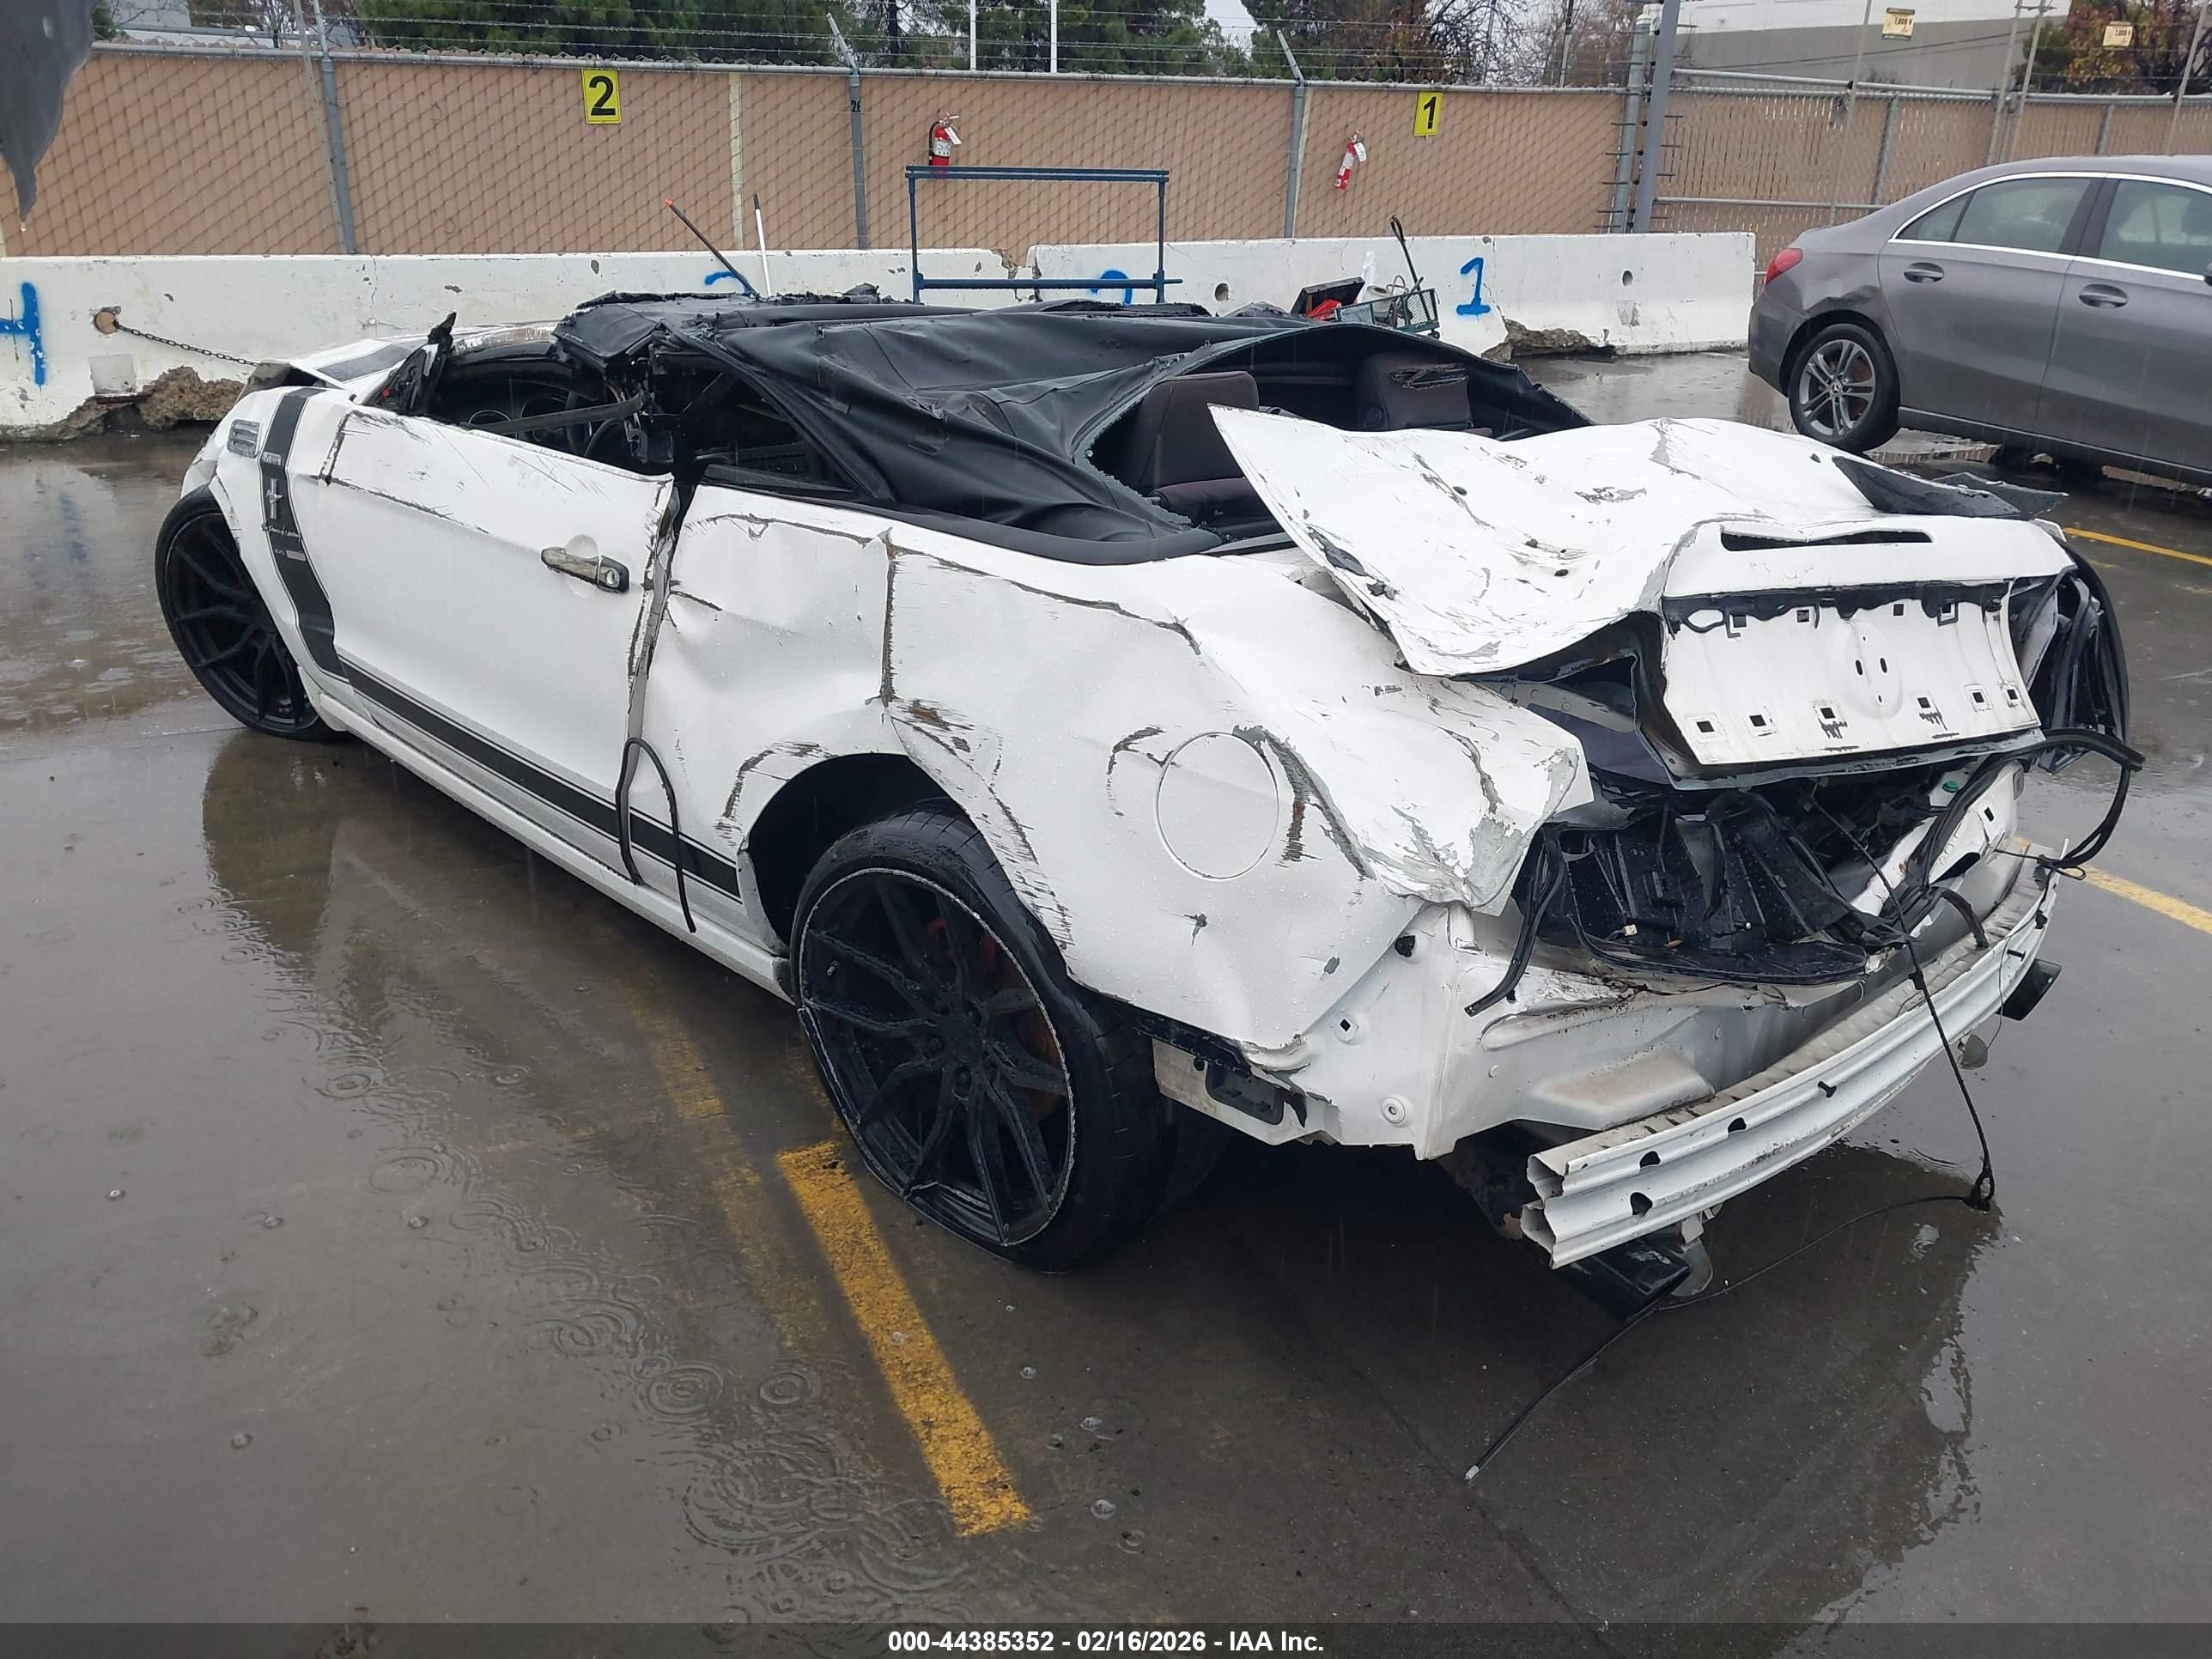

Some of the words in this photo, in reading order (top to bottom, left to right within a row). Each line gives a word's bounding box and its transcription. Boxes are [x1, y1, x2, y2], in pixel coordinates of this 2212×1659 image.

[589, 75, 616, 116] 2
[1423, 96, 1437, 129] 1
[1456, 257, 1491, 315] 1
